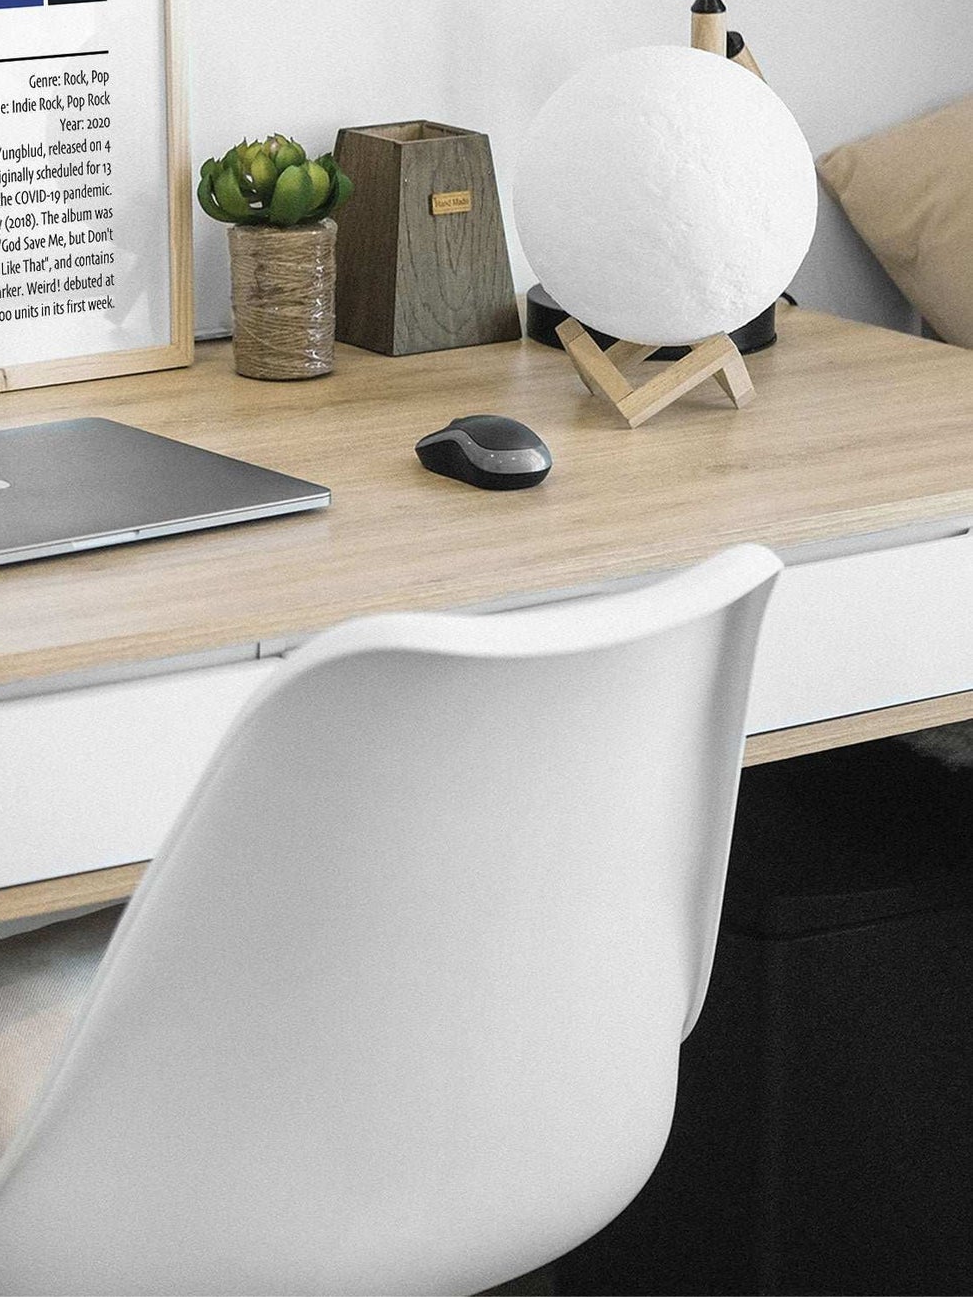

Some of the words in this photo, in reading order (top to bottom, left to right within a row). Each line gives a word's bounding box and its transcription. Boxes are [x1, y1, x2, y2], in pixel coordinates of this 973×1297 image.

[29, 75, 61, 89] Genre:
[63, 69, 89, 86] Rock,
[91, 70, 109, 86] Pop
[12, 97, 37, 113] Indie
[39, 95, 65, 111] Rock,
[67, 95, 85, 111] Pop
[87, 91, 111, 106] Rock
[59, 118, 84, 131] Year:
[87, 117, 111, 129] 2020
[49, 138, 87, 155] released
[89, 141, 101, 152] on
[105, 140, 111, 153] 4
[36, 161, 83, 180] scheduled
[86, 160, 101, 175] for
[102, 163, 111, 176] 13
[15, 189, 61, 205] COVID-19
[63, 183, 112, 204] pandemic.
[5, 213, 39, 233] (2018).
[41, 211, 59, 225] The
[61, 208, 92, 223] album
[95, 207, 113, 219] was
[23, 236, 46, 251] Save
[48, 233, 66, 248] Me,
[69, 231, 85, 245] but
[88, 227, 113, 243] Don't
[1, 260, 21, 275] Like
[23, 257, 52, 273] That",
[54, 253, 72, 269] and
[75, 251, 114, 267] contains
[26, 278, 60, 295] Weird!
[63, 273, 102, 291] debuted
[105, 274, 115, 287] at
[15, 305, 39, 320] units
[41, 303, 50, 317] in
[53, 301, 65, 315] its
[67, 299, 86, 313] first
[88, 295, 115, 311] week.
